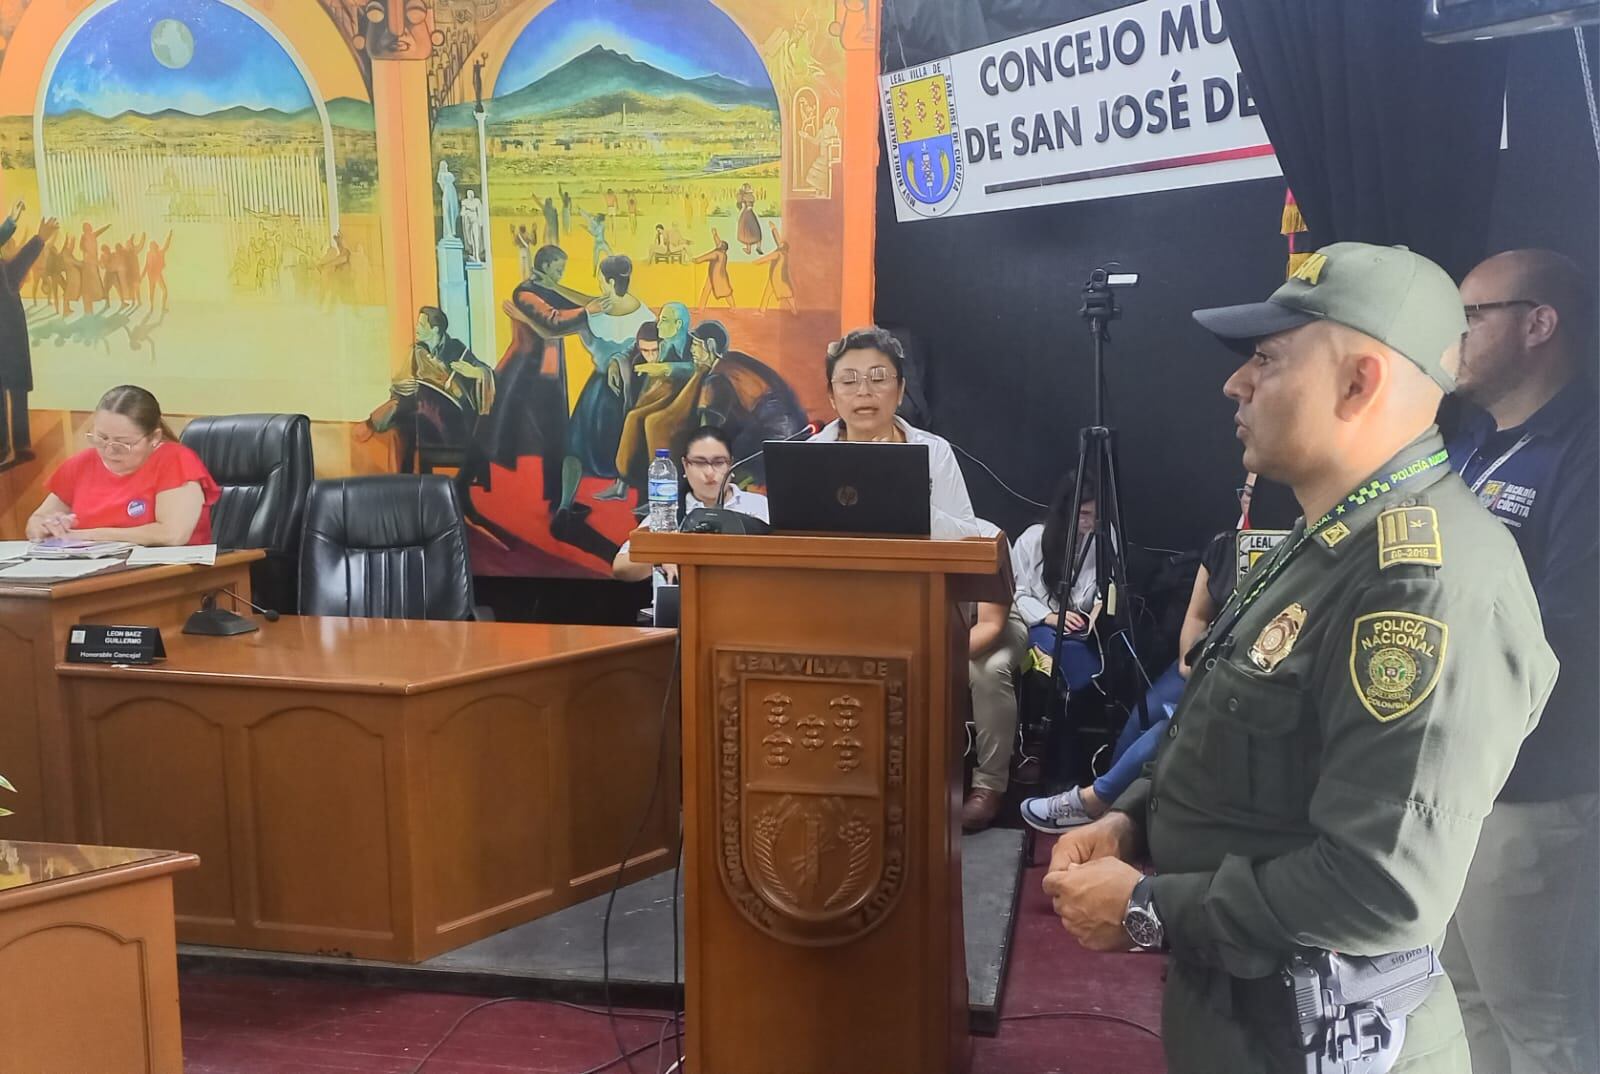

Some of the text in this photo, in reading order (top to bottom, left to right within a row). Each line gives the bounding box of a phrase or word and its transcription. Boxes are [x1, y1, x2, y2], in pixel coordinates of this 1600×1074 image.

[979, 19, 1146, 96] CONCEJO
[890, 63, 942, 85] LEAL VILLA DE
[965, 69, 1259, 164] DE SAN JOSÉ DE
[1390, 459, 1430, 484] POLICÍA
[1250, 537, 1274, 549] LEAL
[1373, 619, 1427, 640] POLICÍA
[1361, 632, 1435, 658] NACIONAL
[735, 655, 786, 671] LEAL
[861, 661, 889, 677] DE
[1405, 948, 1422, 963] pro
